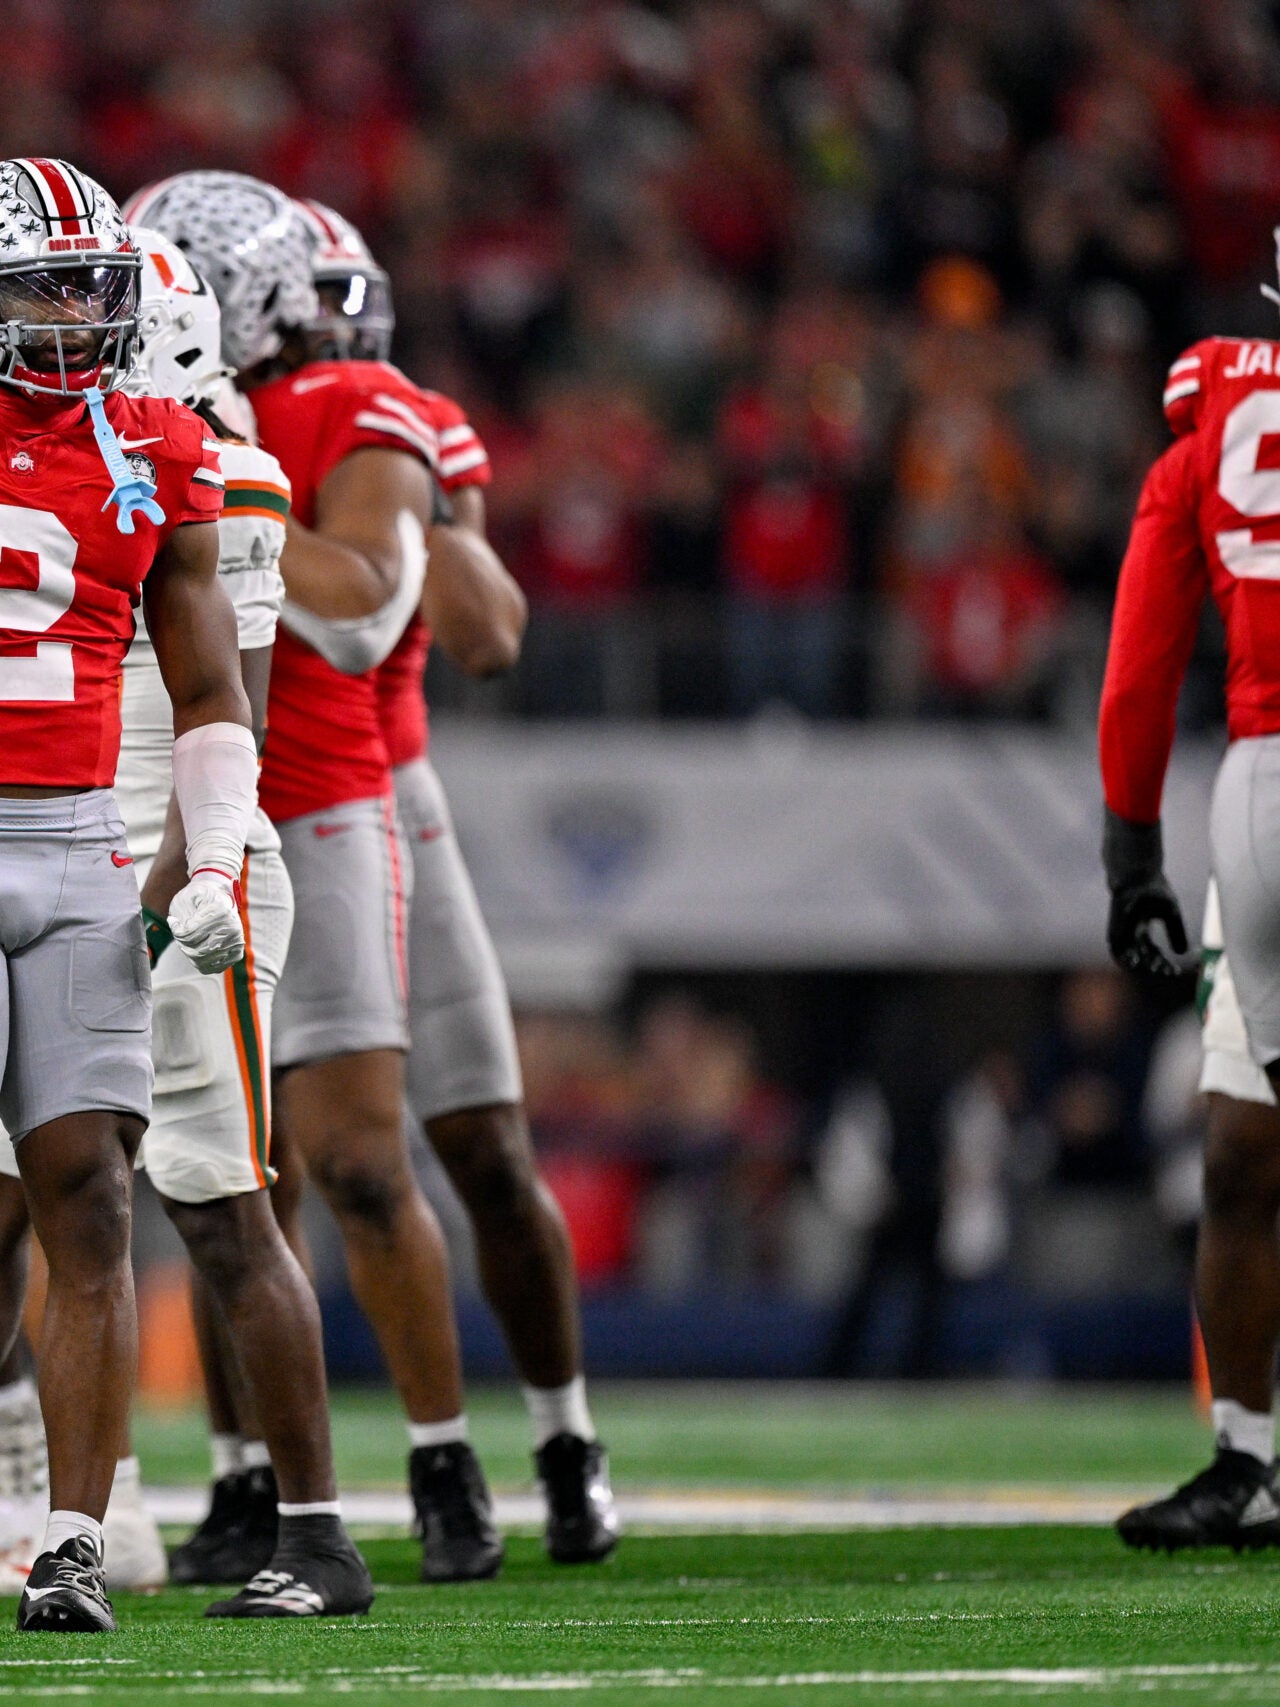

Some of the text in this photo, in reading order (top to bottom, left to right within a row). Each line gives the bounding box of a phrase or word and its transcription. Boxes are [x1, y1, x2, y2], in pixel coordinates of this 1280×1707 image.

[48, 237, 100, 252] OHIO STATE
[1223, 342, 1280, 378] JA
